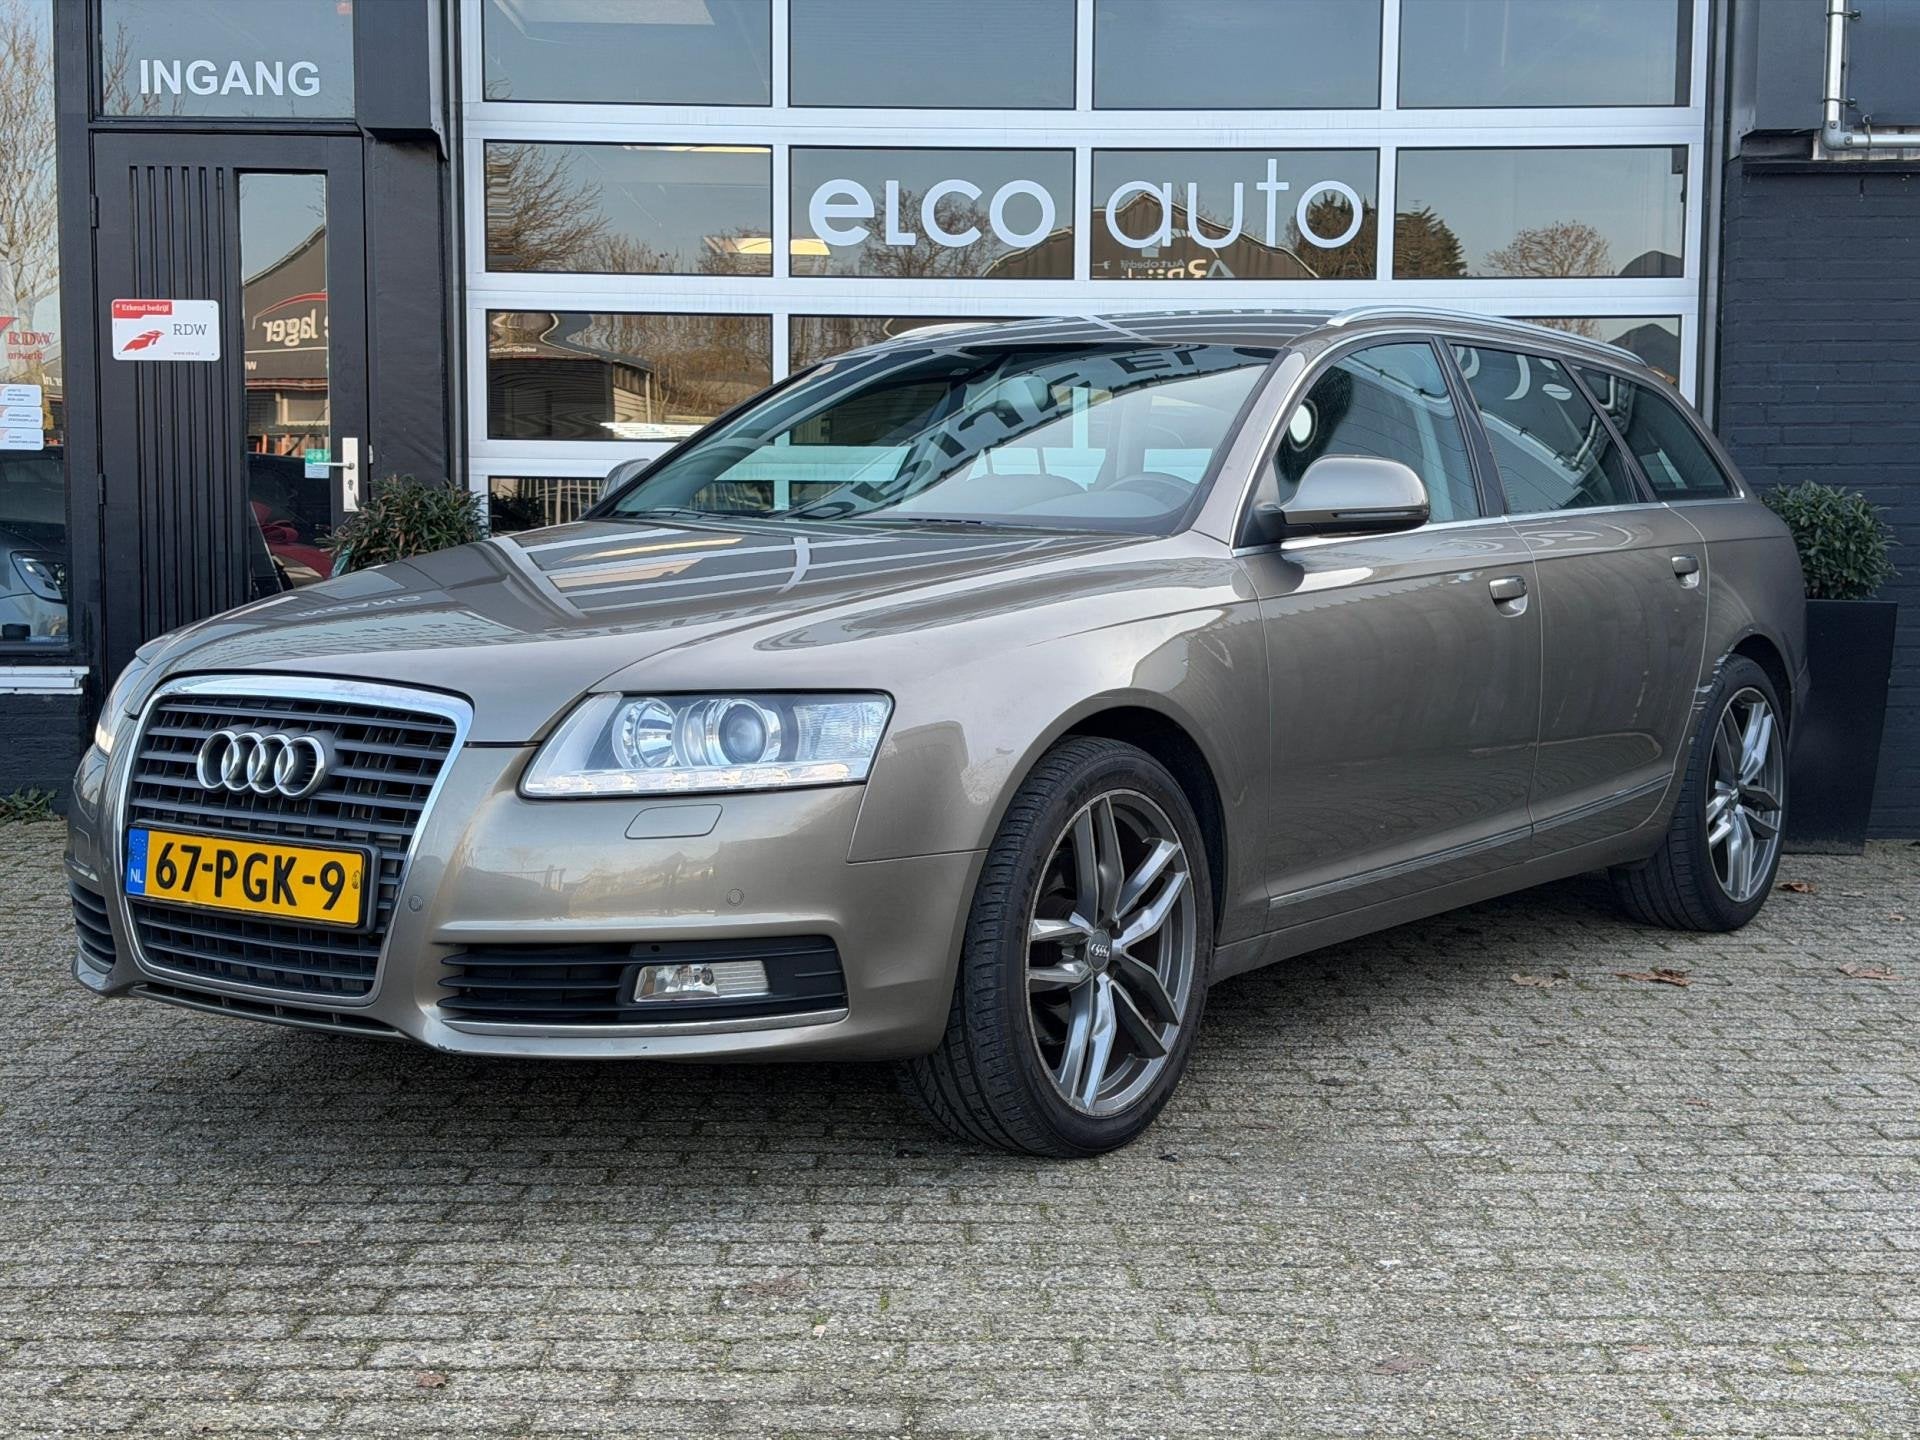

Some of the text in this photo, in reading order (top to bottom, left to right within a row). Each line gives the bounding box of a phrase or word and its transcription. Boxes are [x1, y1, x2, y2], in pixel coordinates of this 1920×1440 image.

[140, 59, 320, 97] INGANG
[1106, 158, 1363, 249] auto
[173, 323, 208, 336] RDW
[130, 842, 346, 910] NL 67-PGK-9
